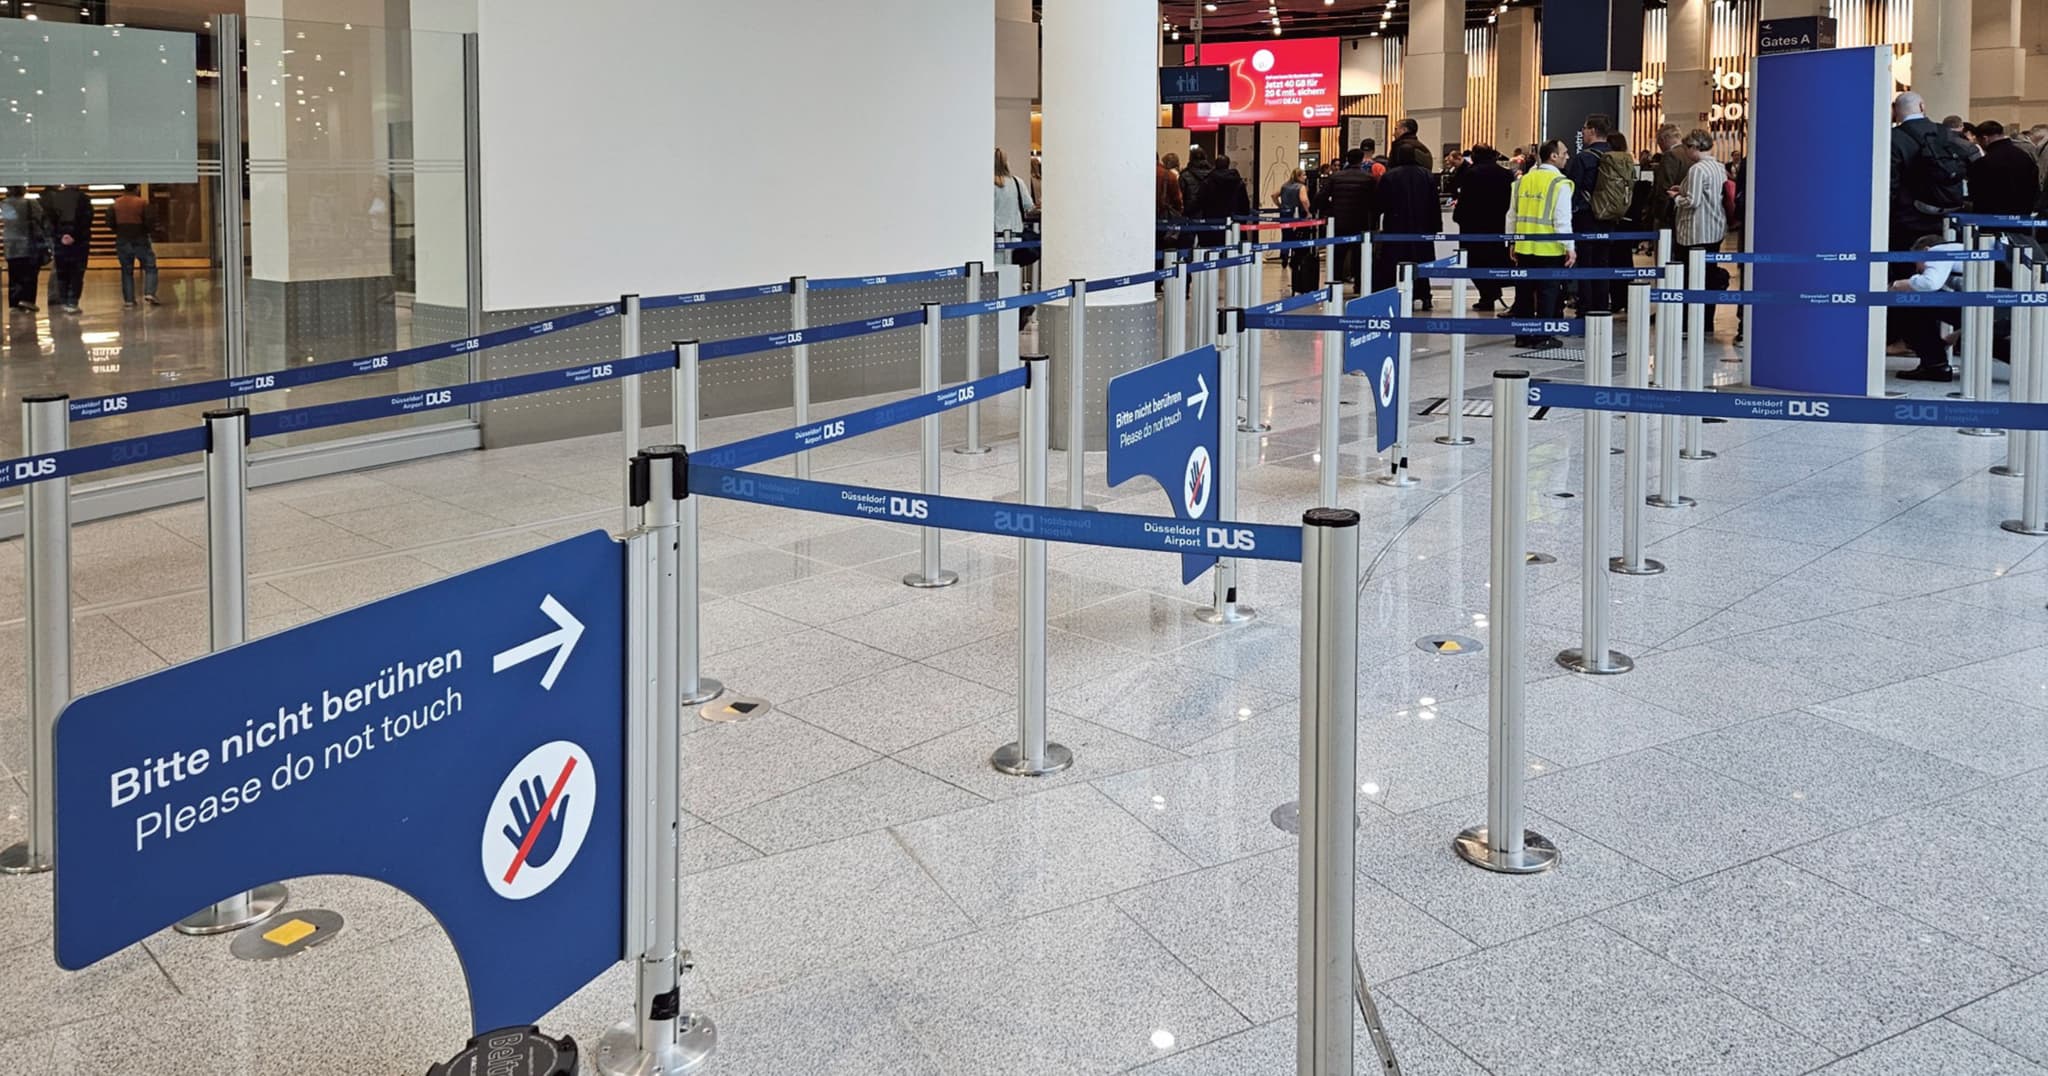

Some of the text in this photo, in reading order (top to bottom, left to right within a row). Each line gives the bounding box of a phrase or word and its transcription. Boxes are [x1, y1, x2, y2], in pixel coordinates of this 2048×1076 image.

[1761, 36, 1798, 47] Gates
[1800, 34, 1810, 44] A
[1284, 79, 1294, 87] 40
[1264, 89, 1274, 97] 20
[1715, 253, 1732, 261] DUS
[1838, 253, 1856, 261] DUS
[1971, 251, 1989, 259] DUS
[1510, 269, 1528, 278] DUS
[1638, 269, 1656, 277] DUS
[1662, 292, 1684, 301] DUS
[1831, 293, 1857, 303] DUS
[2020, 293, 2048, 303] DUS
[882, 317, 894, 328] DUS
[1368, 319, 1391, 330] DUS
[1544, 321, 1569, 332] DUS
[788, 332, 802, 343] DUS
[465, 339, 479, 349] DUS
[372, 356, 389, 368] DUS
[592, 364, 612, 378] DUS
[255, 375, 275, 389] DUS
[426, 390, 451, 406] DUS
[958, 386, 975, 402] DUS
[103, 396, 128, 412] DUS
[1735, 398, 1784, 408] Düsseldorf
[1788, 400, 1830, 417] DUS
[1116, 391, 1182, 428] Bitte nicht berühren
[1751, 406, 1784, 417] Airport
[823, 420, 845, 440] DUS
[1120, 408, 1182, 448] Please do not touch
[15, 457, 57, 480] DUS
[841, 490, 887, 505] Düsseldorf
[856, 503, 887, 515] Airport
[890, 496, 928, 519] DUS
[1144, 522, 1201, 537] Düsseldorf
[1163, 535, 1201, 548] Airport
[1207, 527, 1256, 551] DUS
[111, 649, 463, 807] Bitte nicht berühren
[136, 686, 463, 851] Please do not touch
